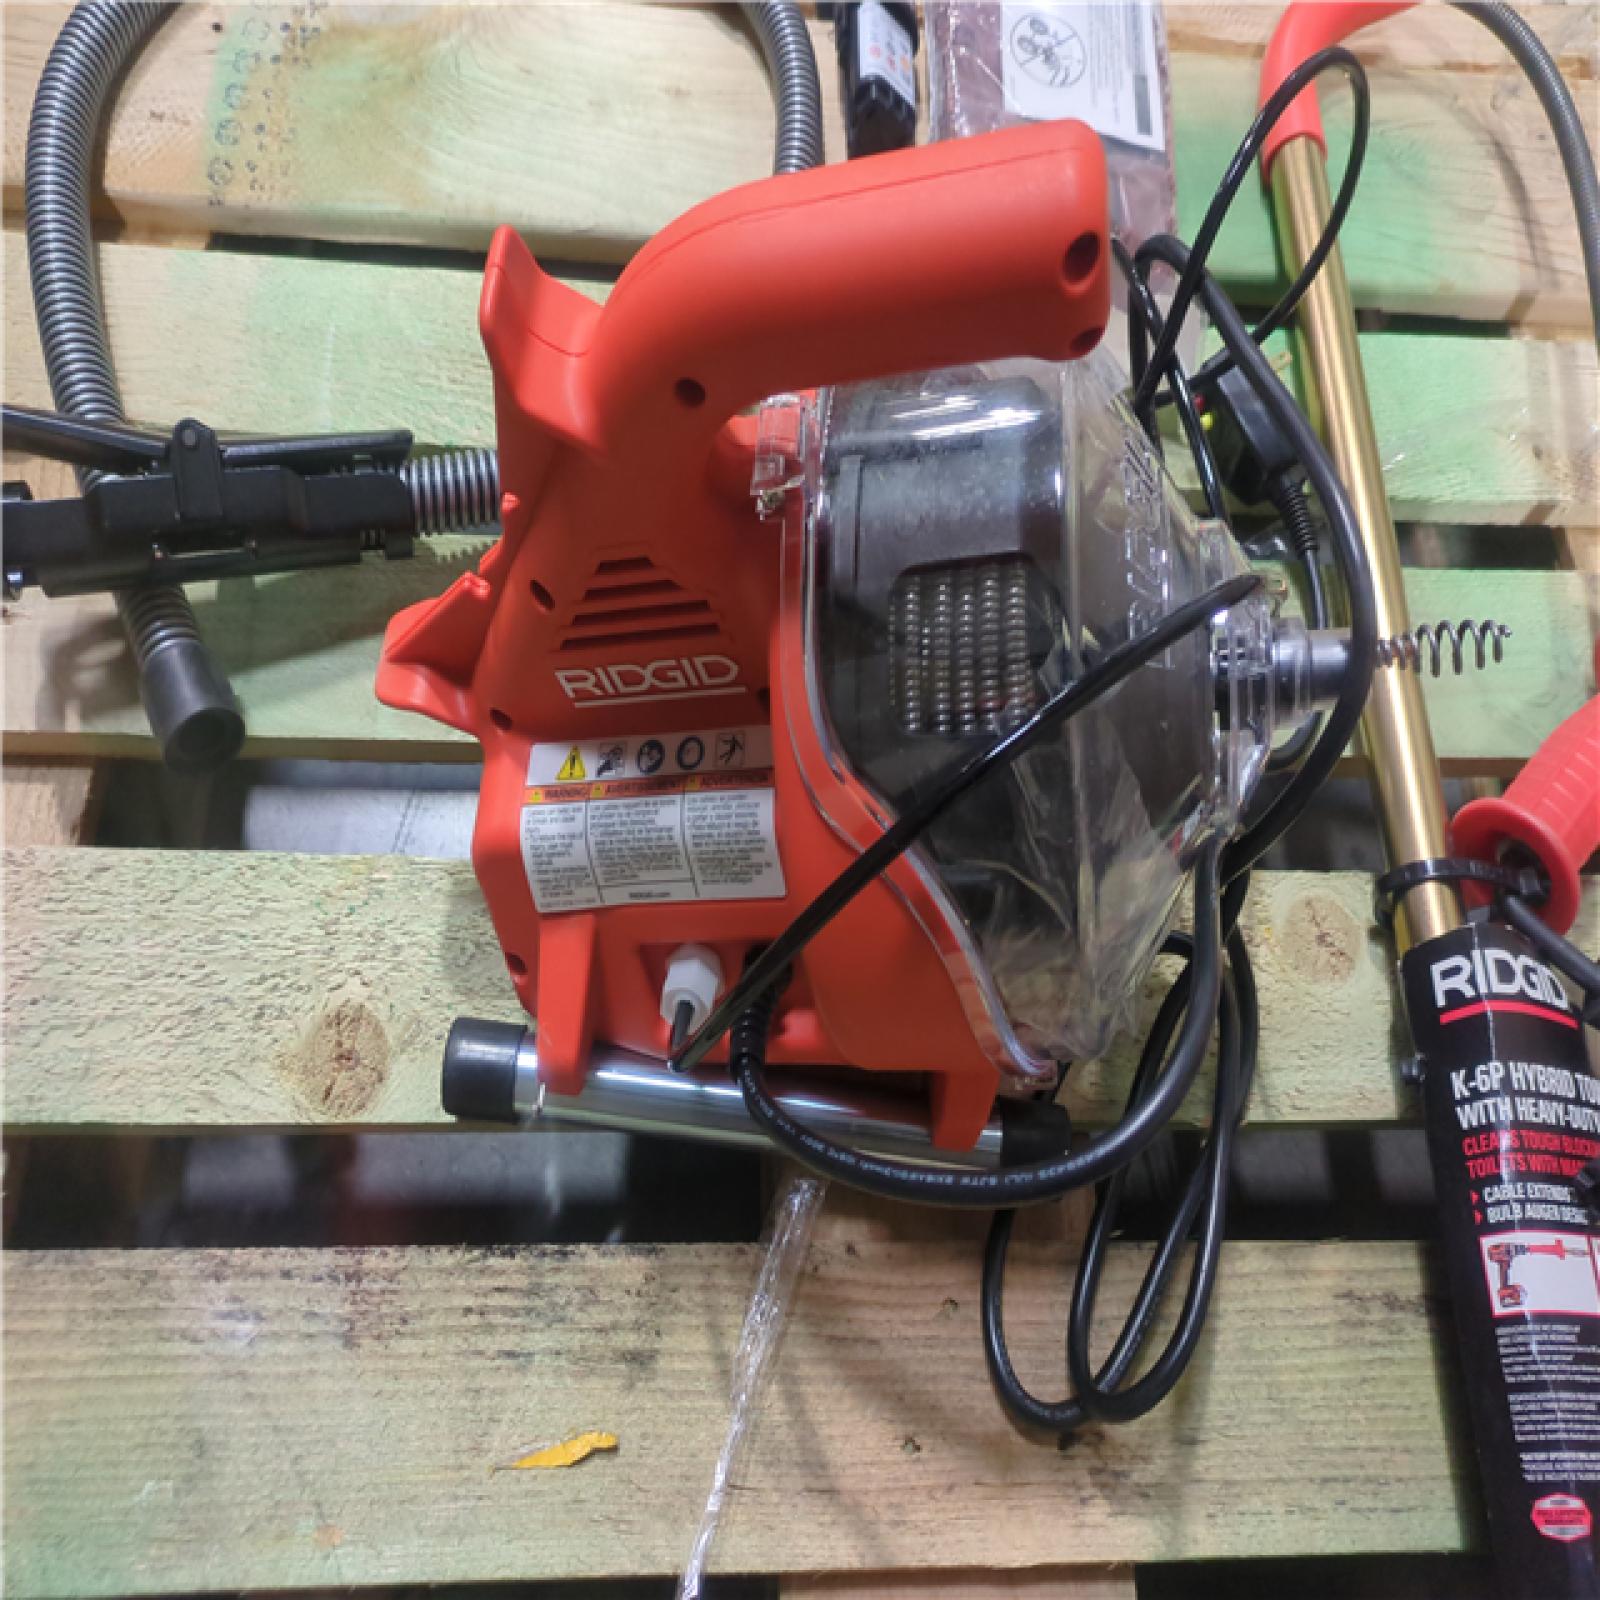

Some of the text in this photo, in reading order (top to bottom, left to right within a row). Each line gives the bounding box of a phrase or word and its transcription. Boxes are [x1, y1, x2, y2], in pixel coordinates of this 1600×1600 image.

[554, 654, 740, 698] RIDGID
[1430, 949, 1570, 1008] RIDGID
[1450, 1060, 1505, 1100] K-6P
[1509, 1061, 1576, 1098] HYBRID
[1455, 1096, 1513, 1130] WITH
[1484, 1183, 1526, 1203] CABLE
